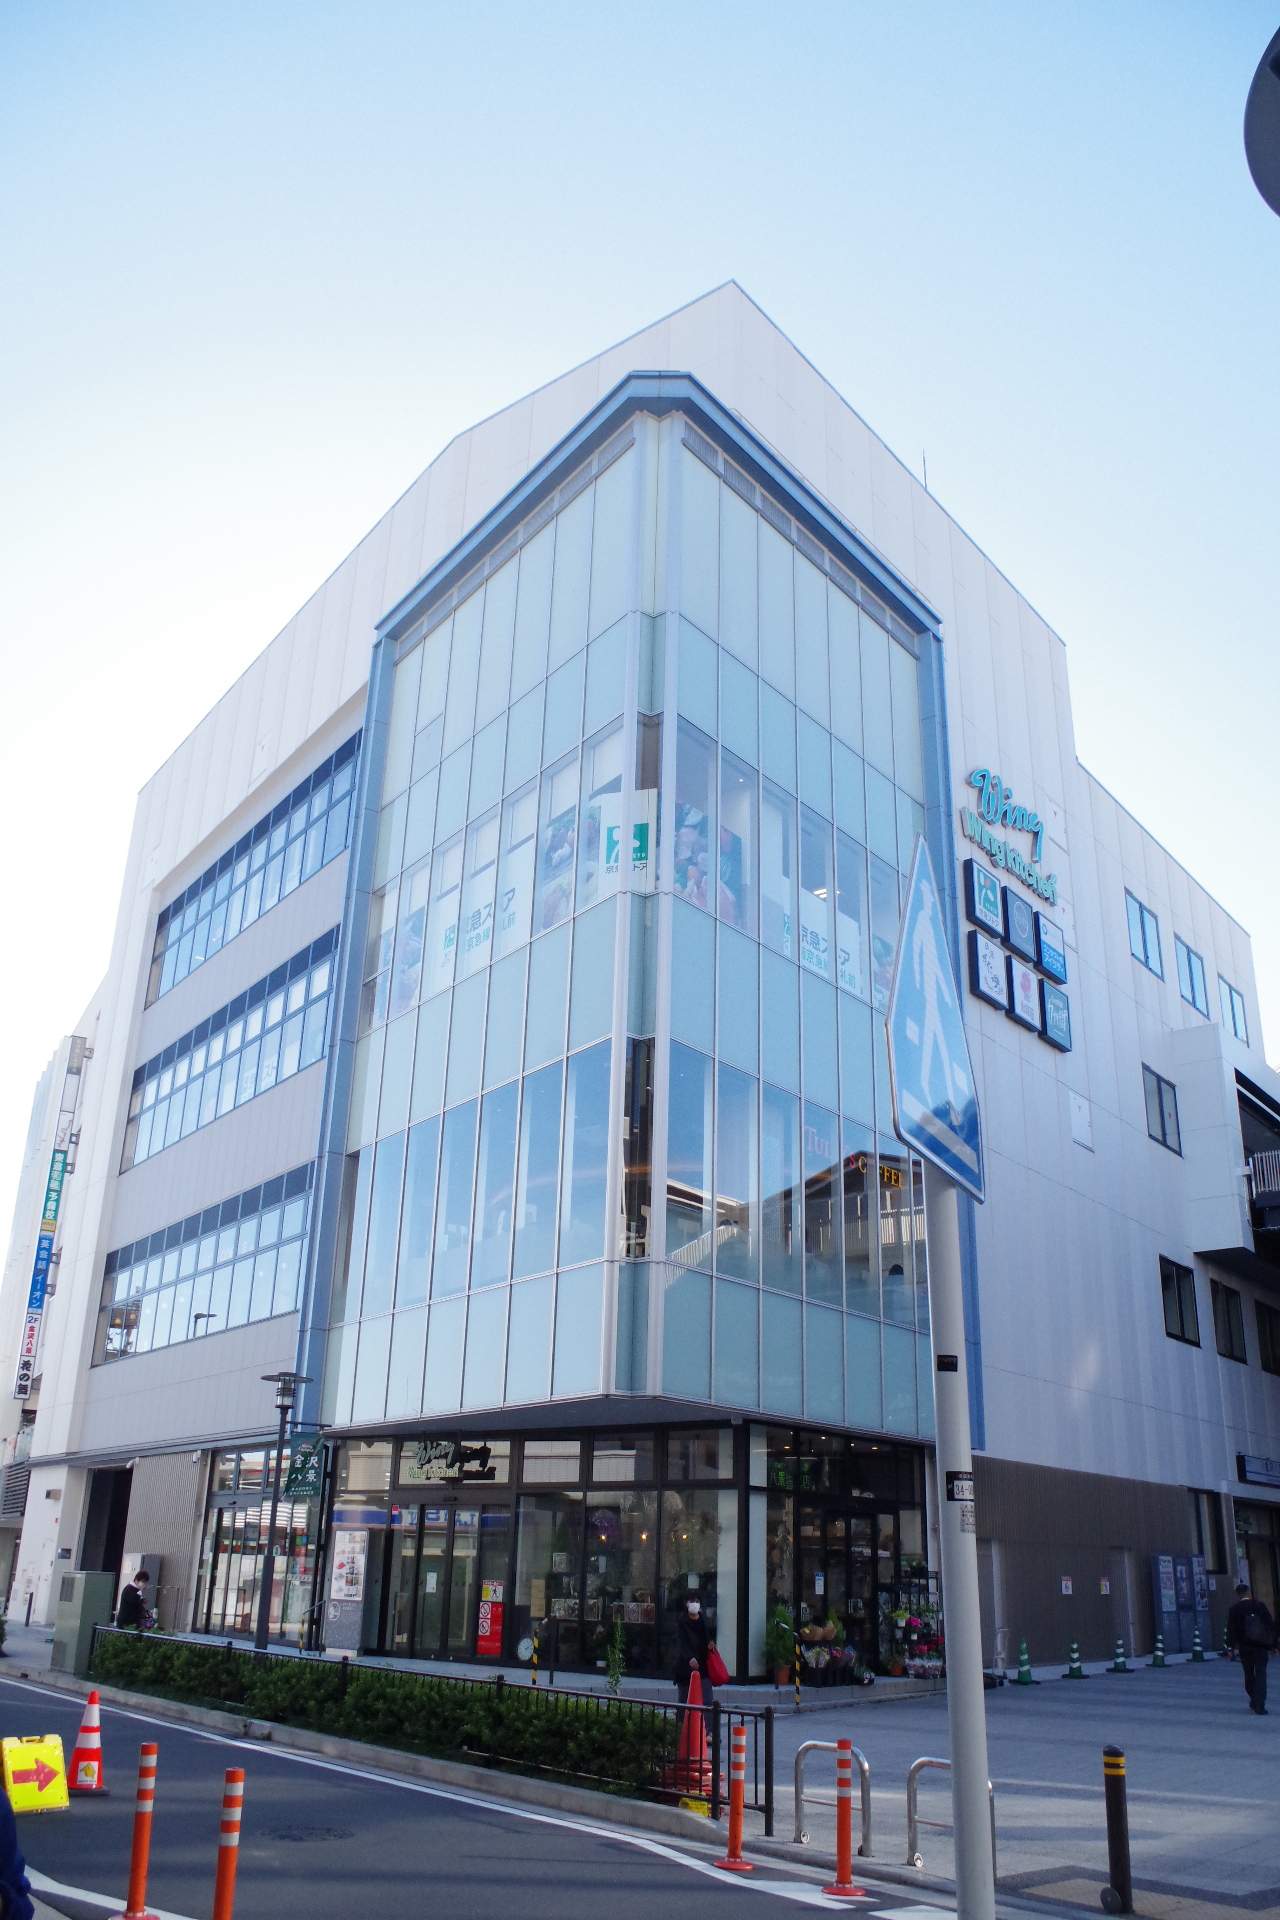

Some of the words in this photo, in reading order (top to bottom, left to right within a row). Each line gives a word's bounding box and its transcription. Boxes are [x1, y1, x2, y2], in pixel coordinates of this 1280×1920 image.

[27, 1315, 39, 1324] 2F
[294, 1454, 319, 1468] 金沢
[291, 1469, 317, 1483] 八景
